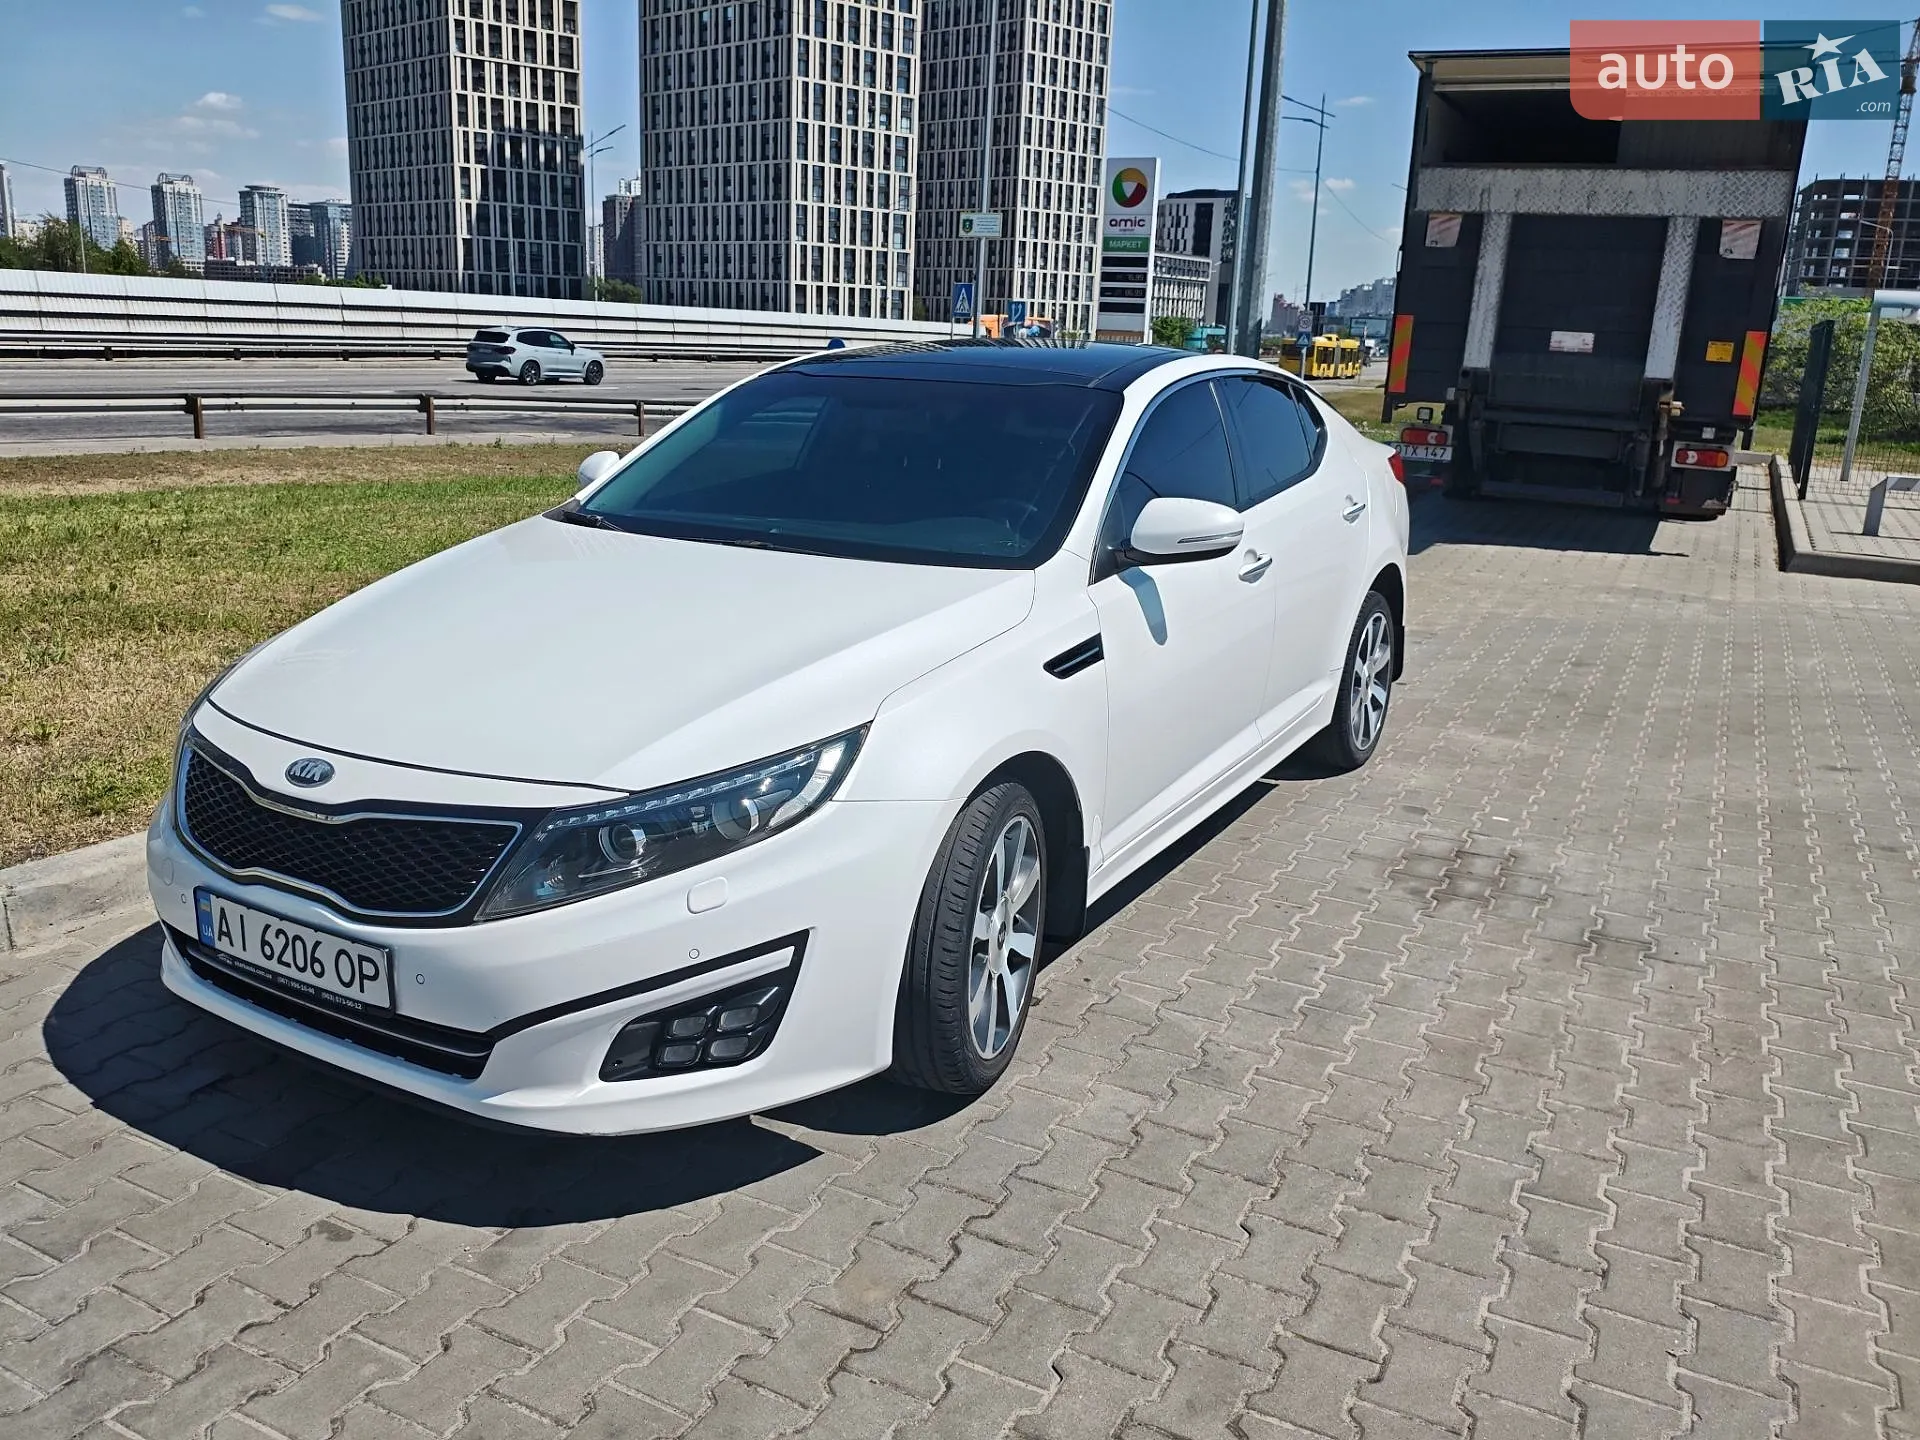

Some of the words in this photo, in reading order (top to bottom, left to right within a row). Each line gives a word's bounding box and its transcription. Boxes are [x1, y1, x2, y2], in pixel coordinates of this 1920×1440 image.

[1109, 216, 1146, 227] amic
[1423, 446, 1447, 458] 147
[289, 760, 331, 782] KIA
[202, 924, 214, 938] UA
[217, 906, 247, 952] AI
[260, 923, 326, 979] 6206
[334, 948, 380, 994] OP
